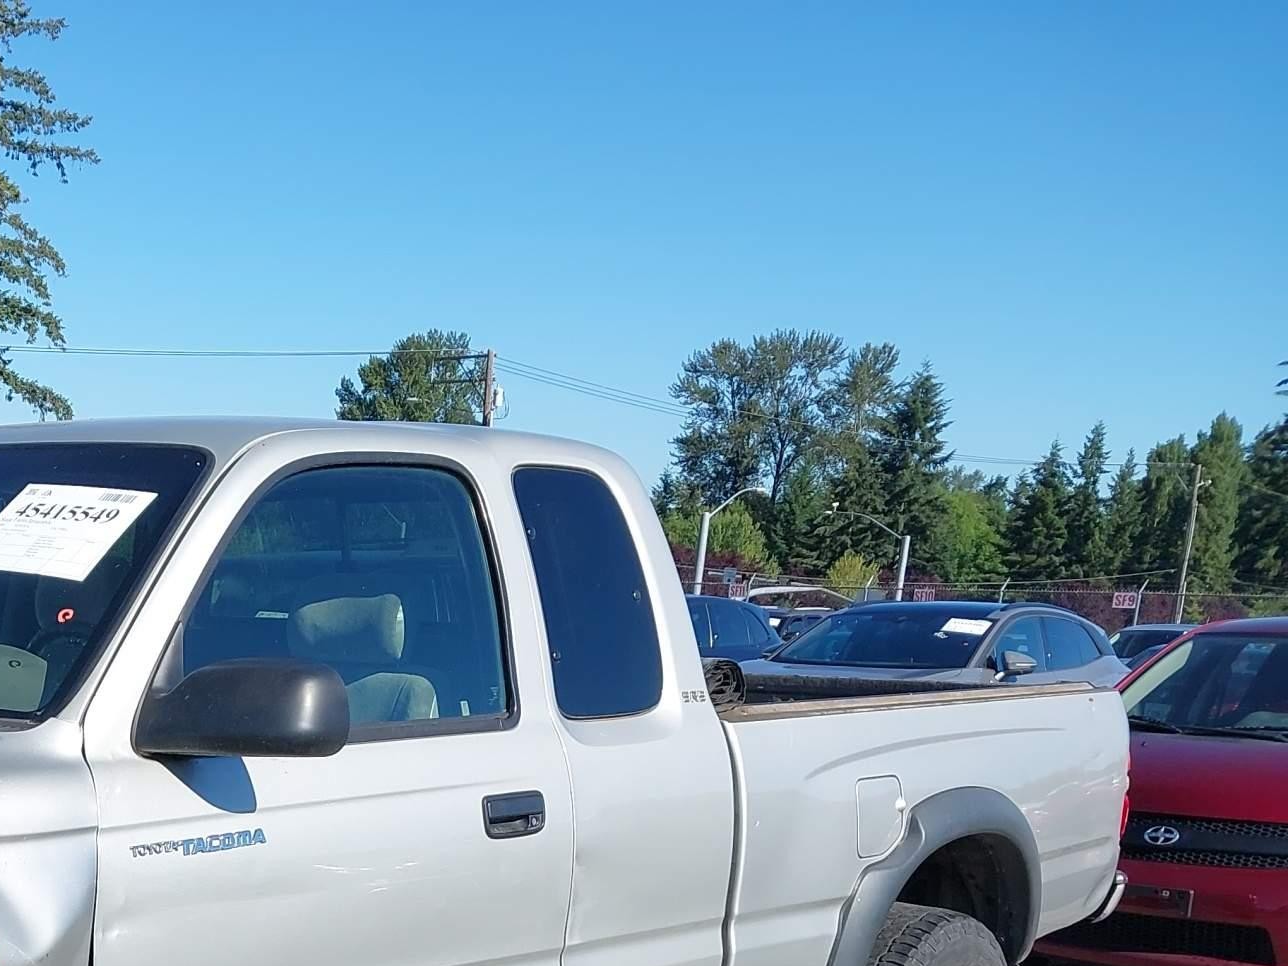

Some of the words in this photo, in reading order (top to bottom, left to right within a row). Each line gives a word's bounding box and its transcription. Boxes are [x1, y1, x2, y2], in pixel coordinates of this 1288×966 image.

[15, 501, 121, 525] 45415549
[1114, 594, 1136, 607] SF9
[181, 827, 268, 857] TACOMA
